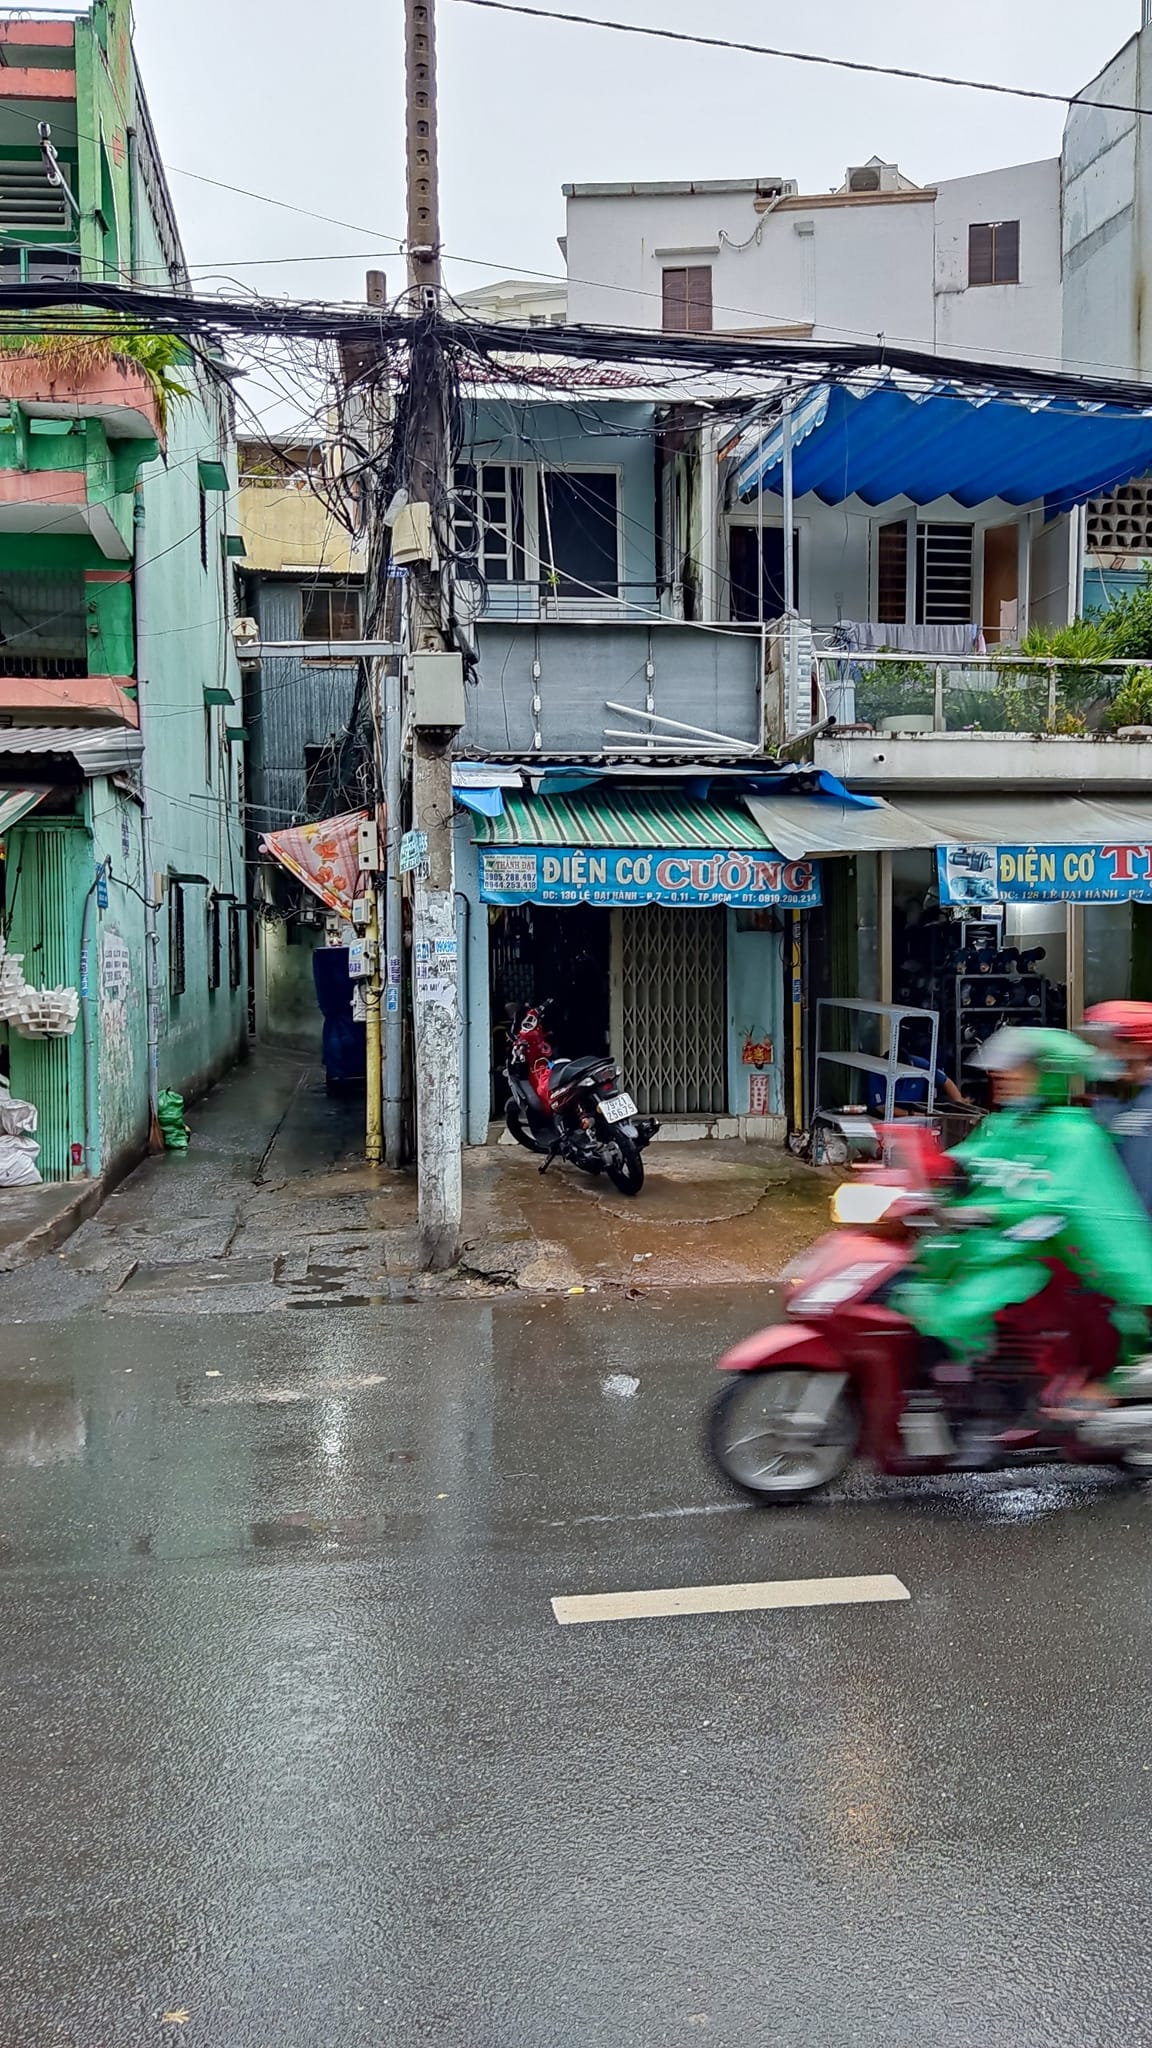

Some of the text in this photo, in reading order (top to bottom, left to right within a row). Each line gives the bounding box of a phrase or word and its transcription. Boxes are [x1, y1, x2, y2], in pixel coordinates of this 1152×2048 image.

[543, 849, 817, 892] ĐIỆN CƠ CƯỜNG
[1000, 846, 1056, 888] ĐIỆN
[1063, 849, 1096, 882] CƠ
[561, 891, 577, 900] 130
[579, 888, 591, 900] LÊ
[612, 889, 637, 901] HÀNH
[646, 892, 661, 901] P.7
[671, 892, 688, 902] Q.11
[698, 892, 732, 902] TP.HCM
[1022, 891, 1039, 900] 128
[1042, 888, 1057, 899] LÊ
[1085, 888, 1118, 899] HÀNH
